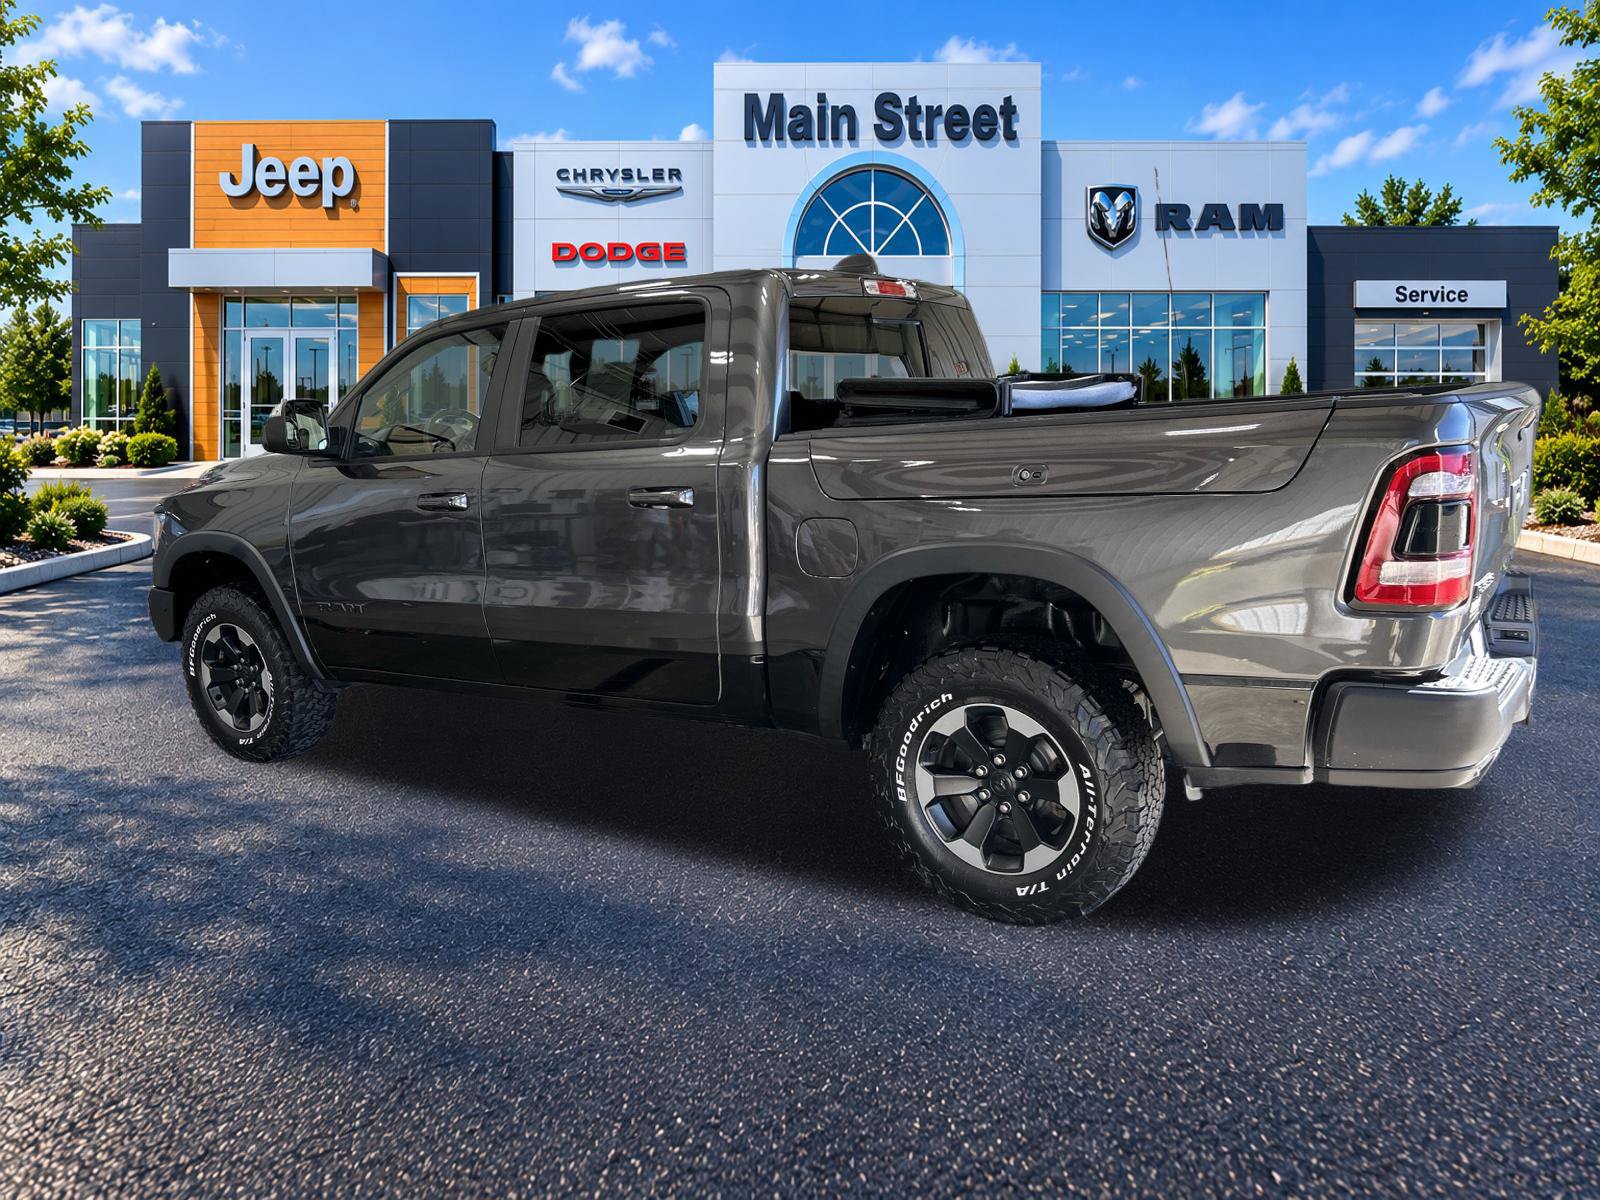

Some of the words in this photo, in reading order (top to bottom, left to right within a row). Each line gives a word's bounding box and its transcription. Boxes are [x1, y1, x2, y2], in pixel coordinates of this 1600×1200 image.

[744, 92, 856, 142] Main
[873, 92, 1018, 142] Street
[218, 144, 355, 208] Jeep
[556, 167, 682, 183] CHRYSLER
[1155, 203, 1283, 230] RAM
[551, 242, 686, 262] DODGE
[1395, 284, 1469, 304] Service
[189, 613, 217, 677] BFGoodrich
[896, 693, 953, 802] BFGoodrich
[1057, 763, 1097, 881] All-Terrain
[1016, 881, 1049, 896] T/A
